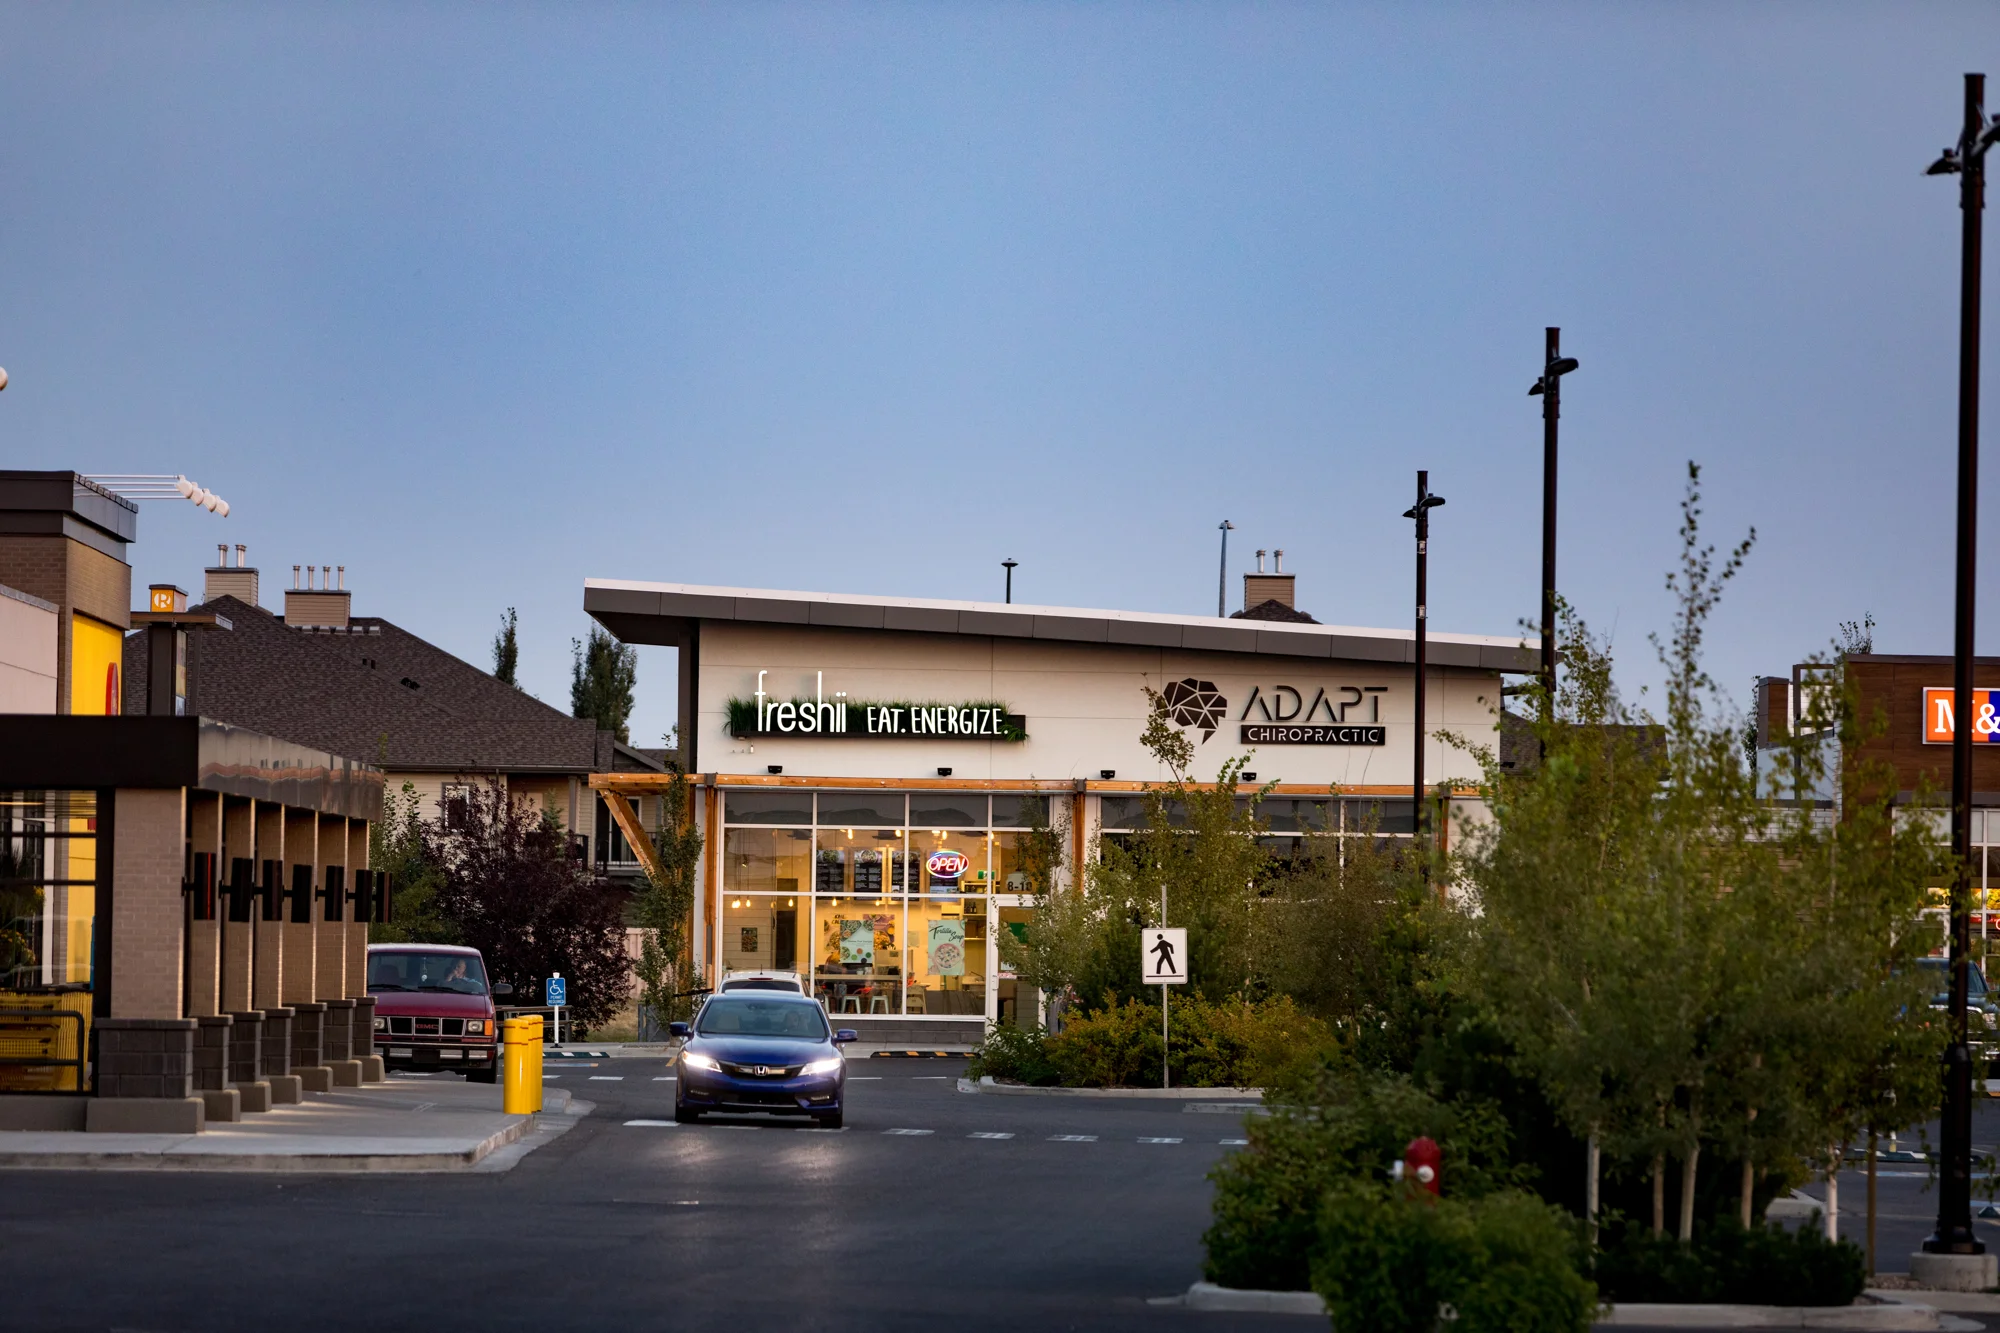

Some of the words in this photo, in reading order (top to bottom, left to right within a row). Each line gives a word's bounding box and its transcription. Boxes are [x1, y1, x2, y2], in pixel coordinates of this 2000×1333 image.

[755, 670, 847, 733] freshii
[867, 706, 906, 734] EAT.
[911, 706, 1009, 735] ENERGIZE.
[1240, 685, 1389, 723] ADAPT
[1247, 727, 1379, 742] CHIROPRACTIC
[929, 857, 966, 872] OPEN
[948, 931, 964, 943] Soup
